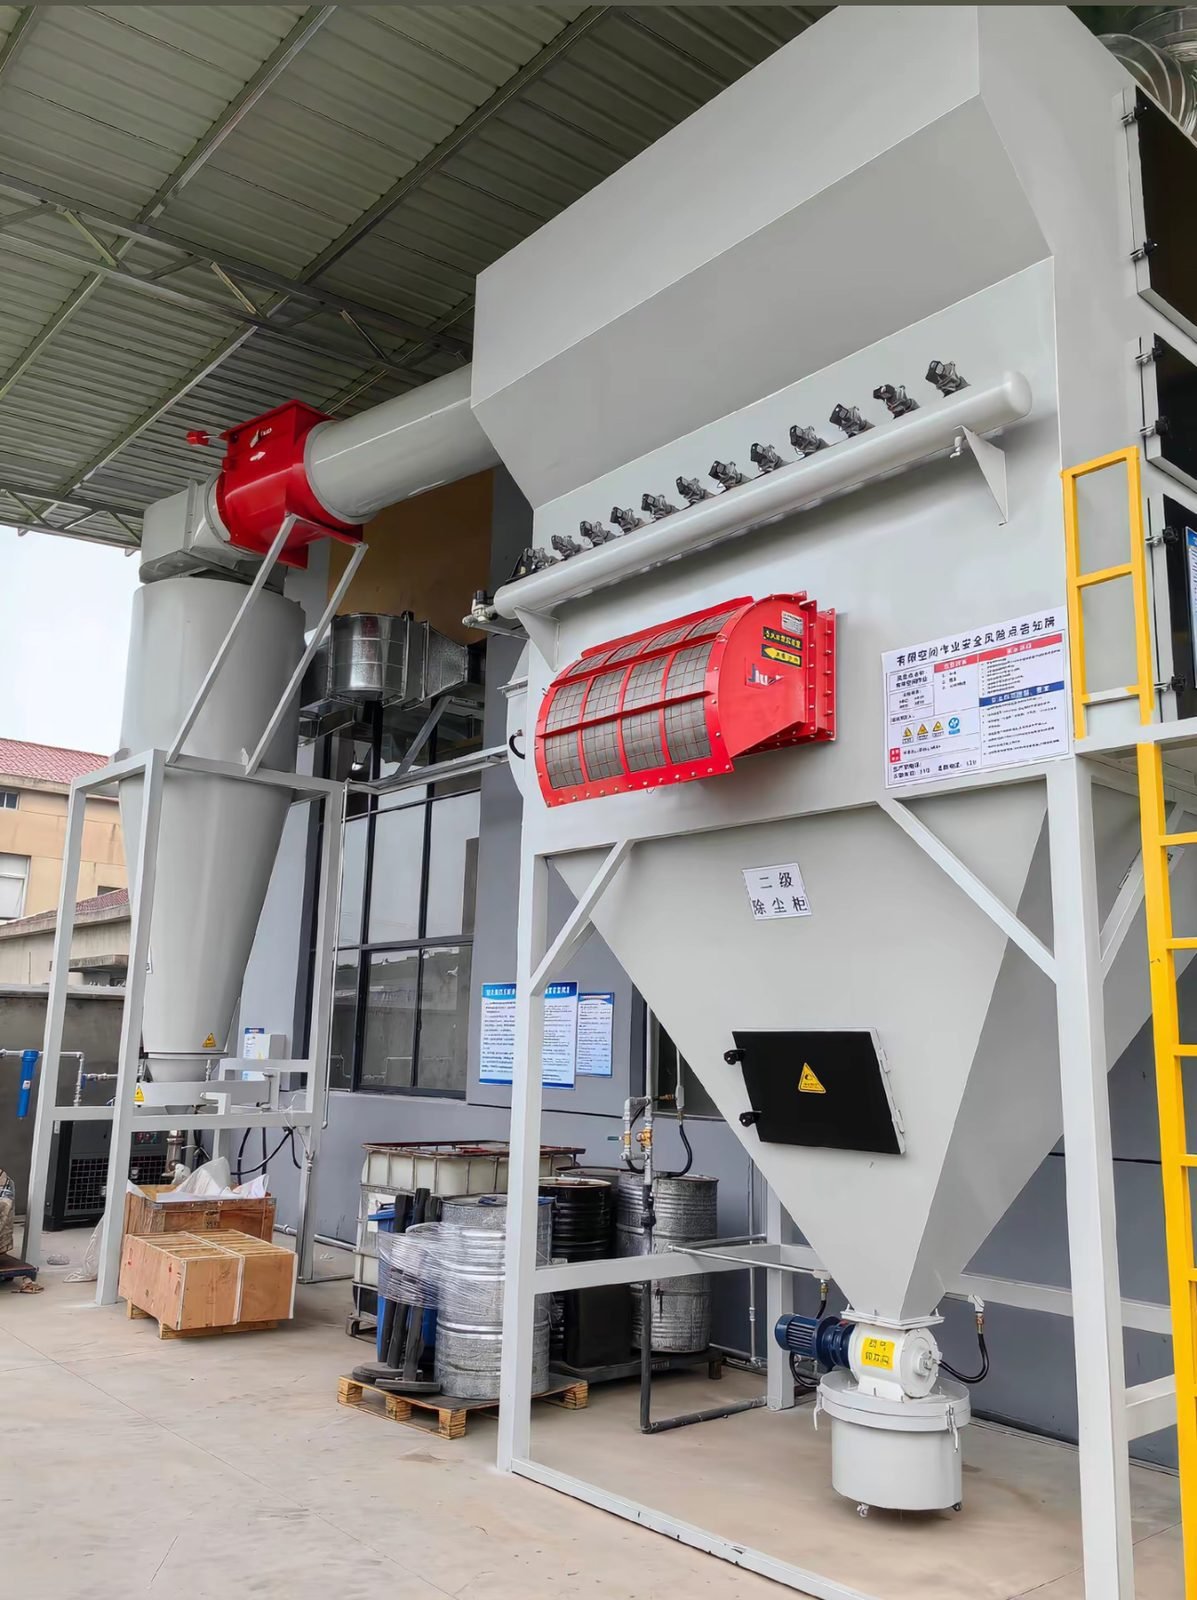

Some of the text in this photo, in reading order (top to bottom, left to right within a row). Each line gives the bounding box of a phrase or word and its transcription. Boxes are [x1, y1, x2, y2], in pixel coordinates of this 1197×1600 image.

[896, 616, 1057, 667] 有限空间作业安全风险点告知牌
[759, 871, 794, 889] 二级
[752, 895, 808, 916] 除尘柜
